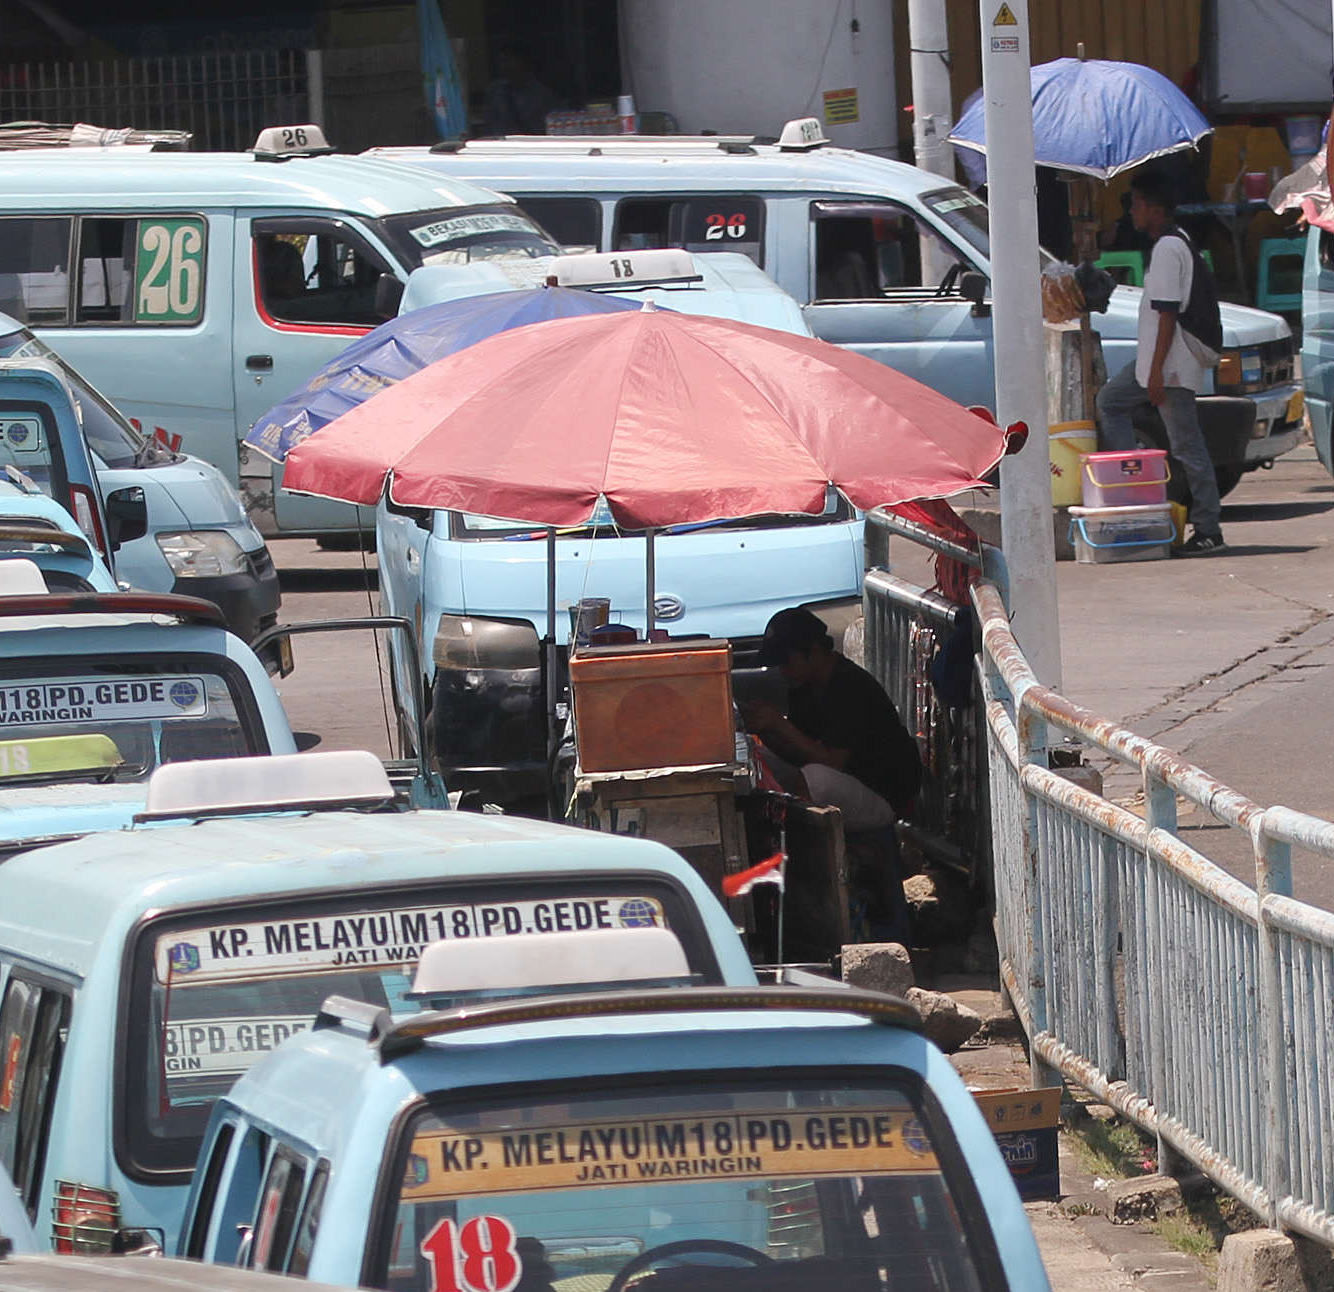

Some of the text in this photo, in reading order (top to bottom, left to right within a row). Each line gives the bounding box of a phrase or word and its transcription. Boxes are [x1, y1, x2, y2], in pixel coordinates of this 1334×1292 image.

[282, 128, 308, 148] 26
[427, 218, 468, 236] BEKASI
[705, 213, 747, 240] 26
[139, 225, 202, 315] 26
[610, 258, 635, 278] 18
[49, 681, 165, 708] PD.GEDE
[209, 928, 255, 960] KP.
[264, 915, 390, 955] MELAYU
[399, 909, 470, 945] M18
[482, 900, 611, 938] PD.GEDE
[331, 947, 379, 967] JATI
[440, 1115, 893, 1173] KP. MELAYU M18 PD.GEDE
[576, 1155, 762, 1183] JATI WARINGIN
